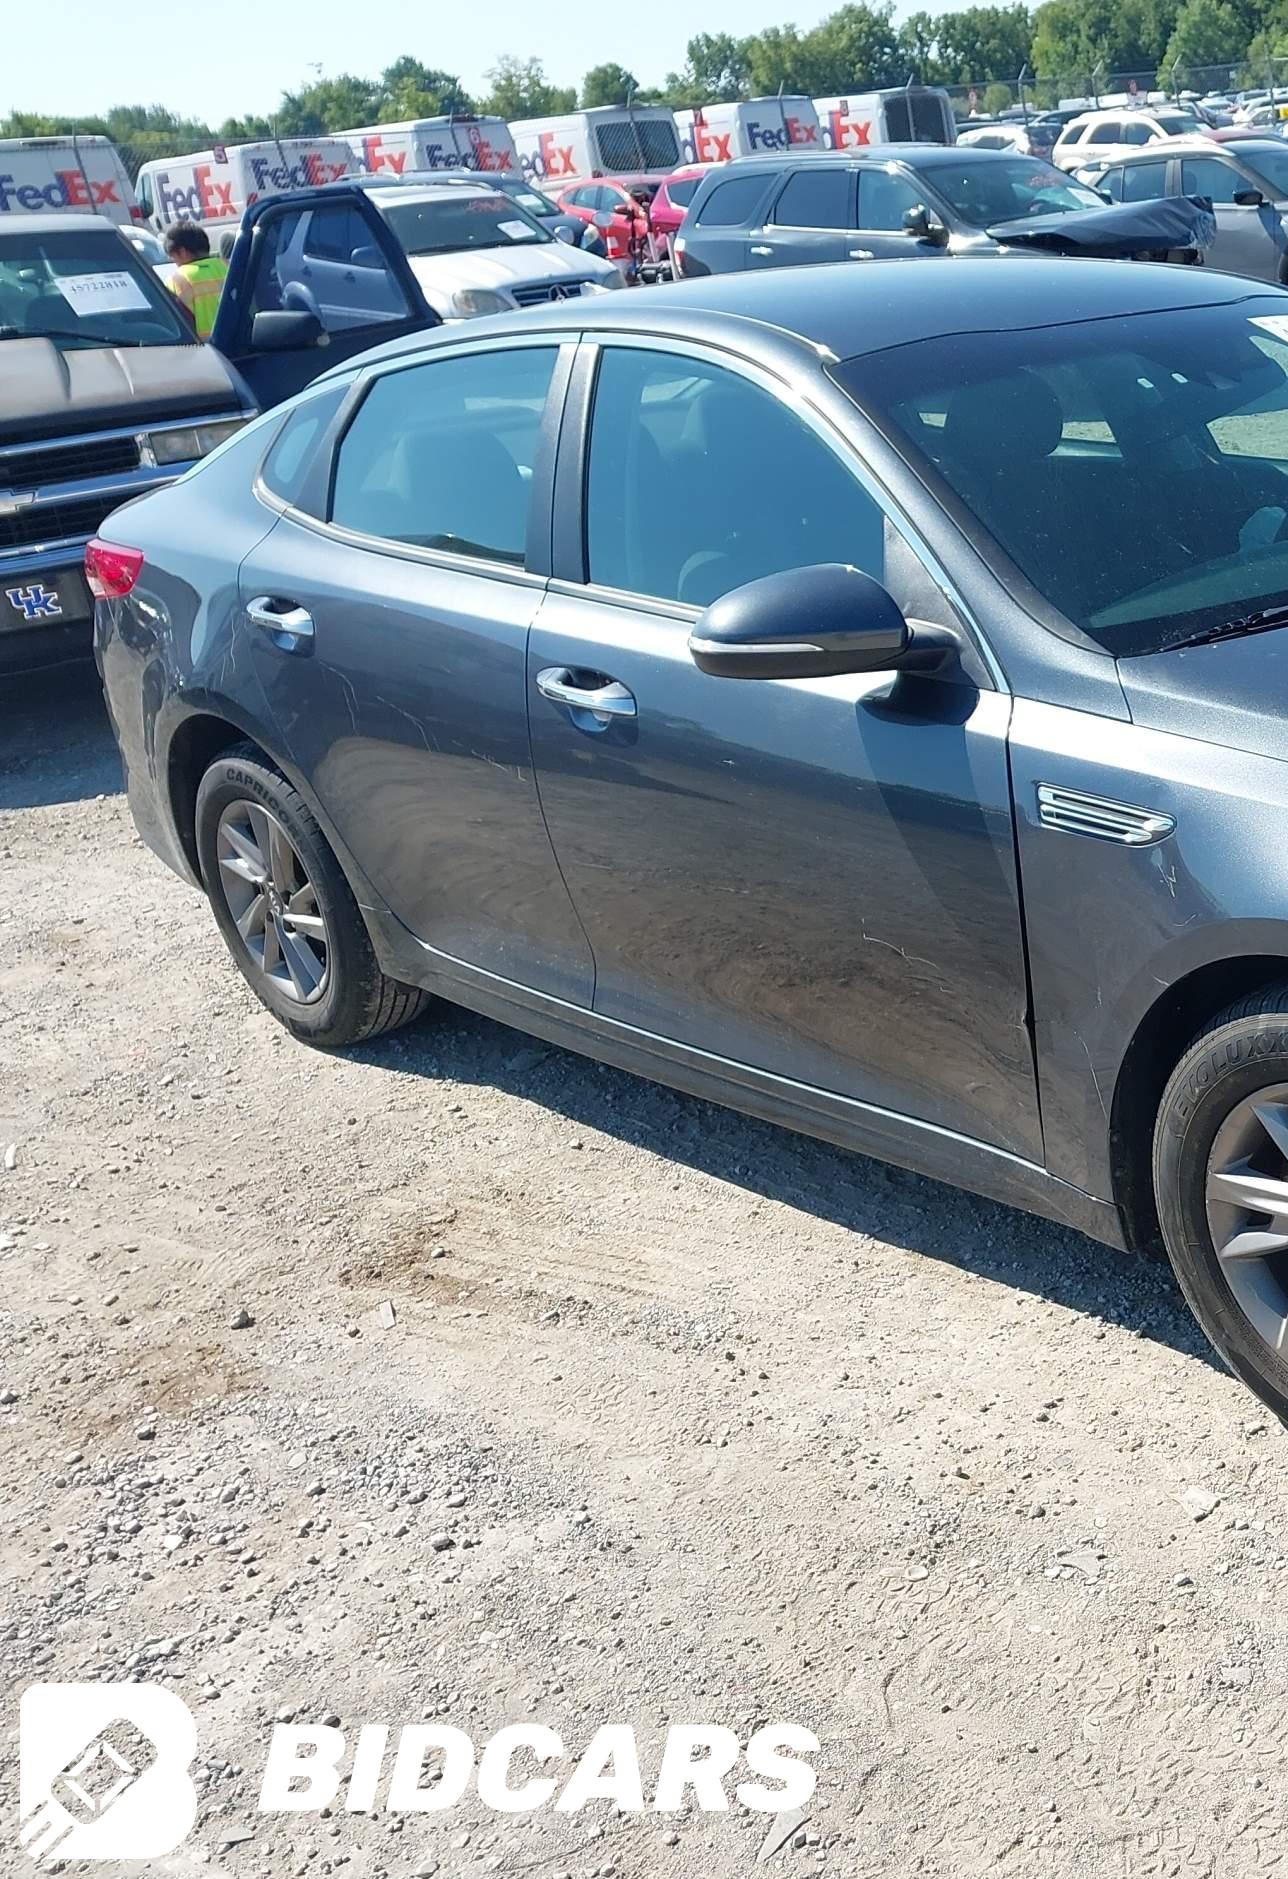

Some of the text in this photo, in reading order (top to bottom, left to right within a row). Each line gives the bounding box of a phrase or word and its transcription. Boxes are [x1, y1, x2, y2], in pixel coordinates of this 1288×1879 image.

[682, 118, 731, 163] dEx
[747, 117, 817, 150] FedEx
[822, 110, 871, 149] dEx
[214, 145, 228, 163] 5
[519, 131, 577, 183] edEx
[0, 169, 120, 211] FedEx
[156, 164, 237, 224] FedEx
[5, 584, 62, 620] UK
